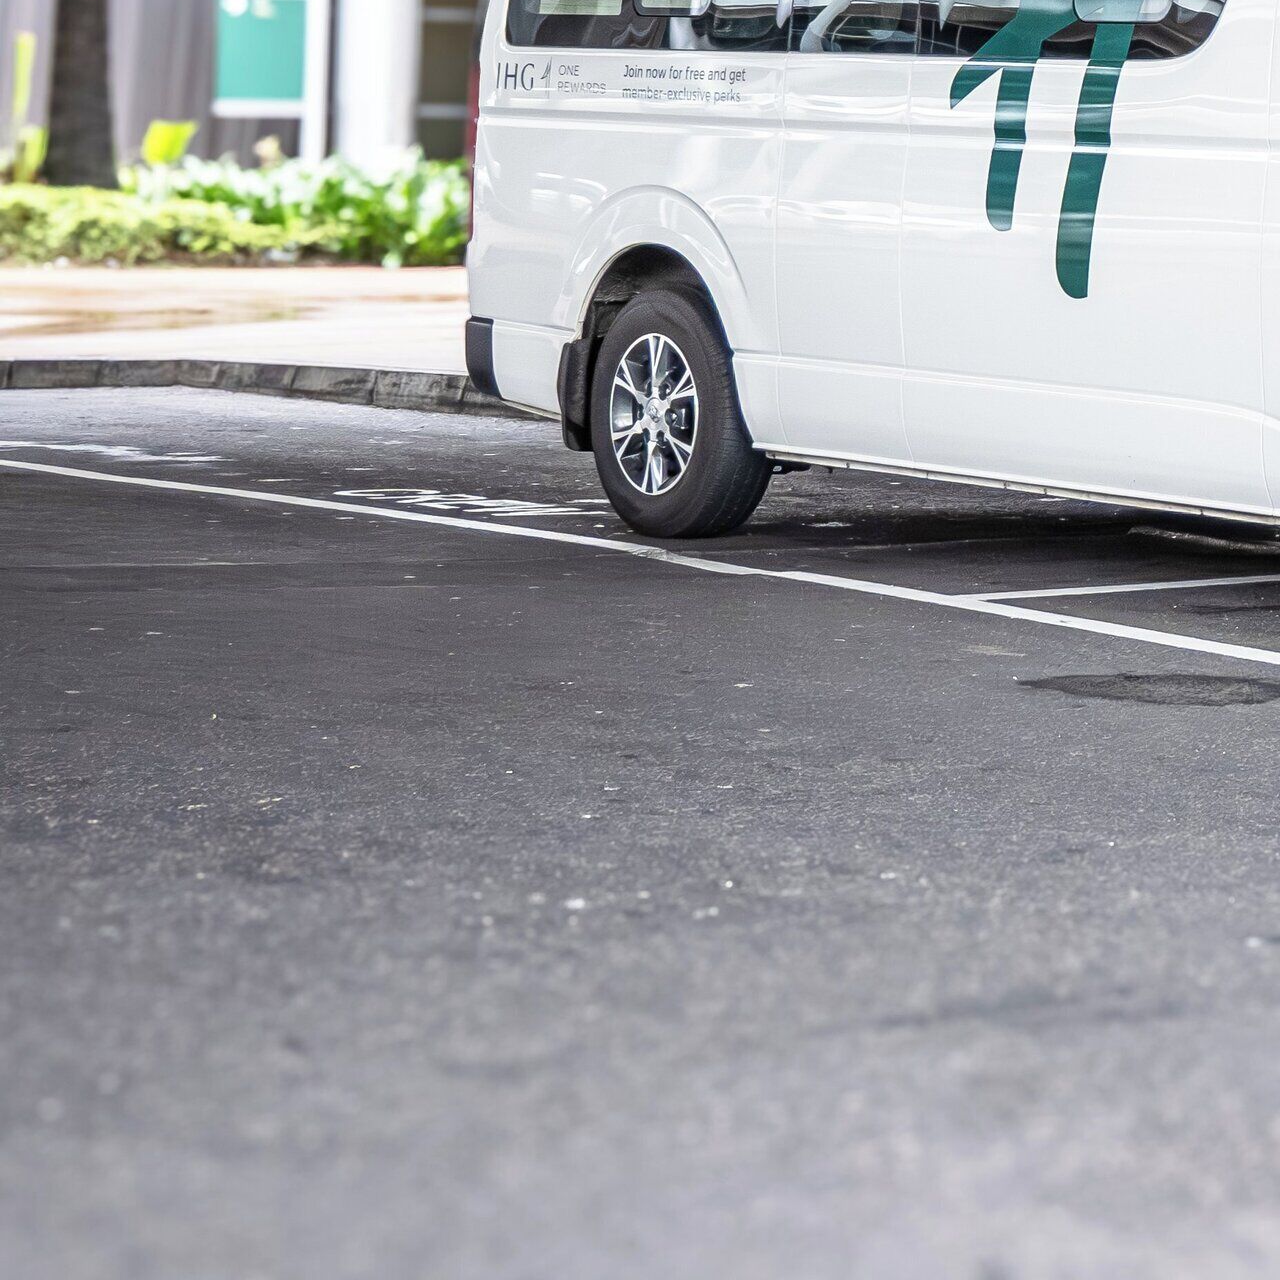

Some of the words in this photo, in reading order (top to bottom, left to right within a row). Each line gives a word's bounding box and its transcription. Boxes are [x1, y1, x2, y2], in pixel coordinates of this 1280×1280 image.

[496, 62, 534, 91] IHG
[558, 64, 580, 77] ONE
[623, 64, 643, 80] Join
[645, 67, 666, 80] now
[668, 65, 684, 81] for
[685, 65, 705, 81] free
[708, 64, 727, 82] and
[729, 66, 747, 88] get
[557, 81, 607, 95] REWARDS
[622, 86, 712, 102] member-exclusive
[713, 87, 741, 105] perks
